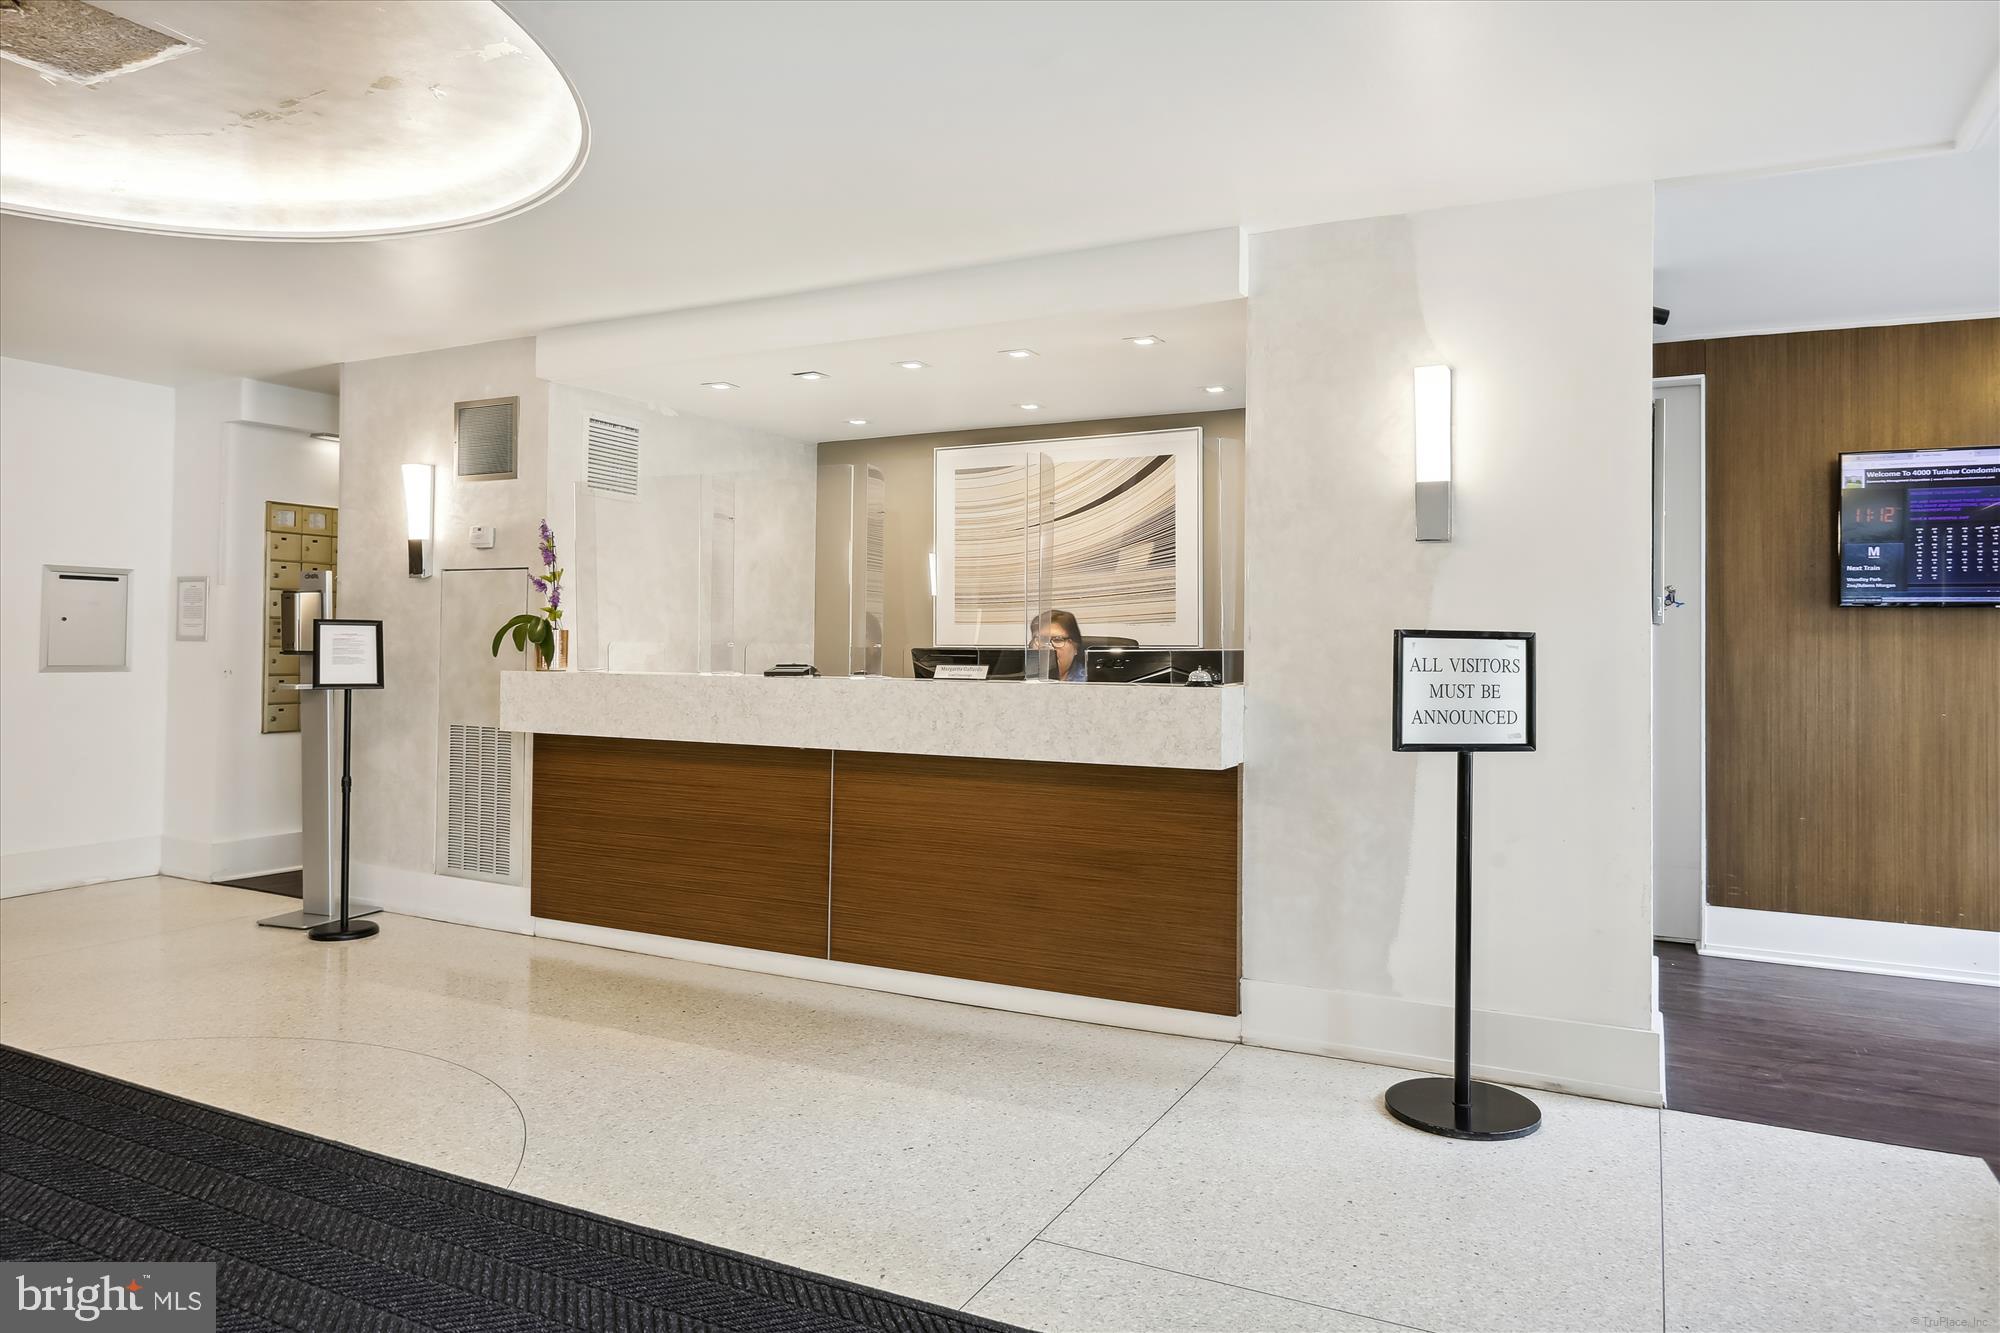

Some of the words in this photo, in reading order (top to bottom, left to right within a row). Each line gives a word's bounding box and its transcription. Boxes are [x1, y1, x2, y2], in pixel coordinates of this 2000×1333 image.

[1932, 468, 1960, 476] Tunlaw
[1856, 507, 1895, 523] 11:12
[1868, 546, 1880, 556] M
[1409, 657, 1443, 673] ALL
[1449, 657, 1521, 674] VISITORS
[1428, 683, 1475, 699] MUST
[1481, 684, 1501, 699] BE
[1411, 709, 1518, 725] ANNOUNCED
